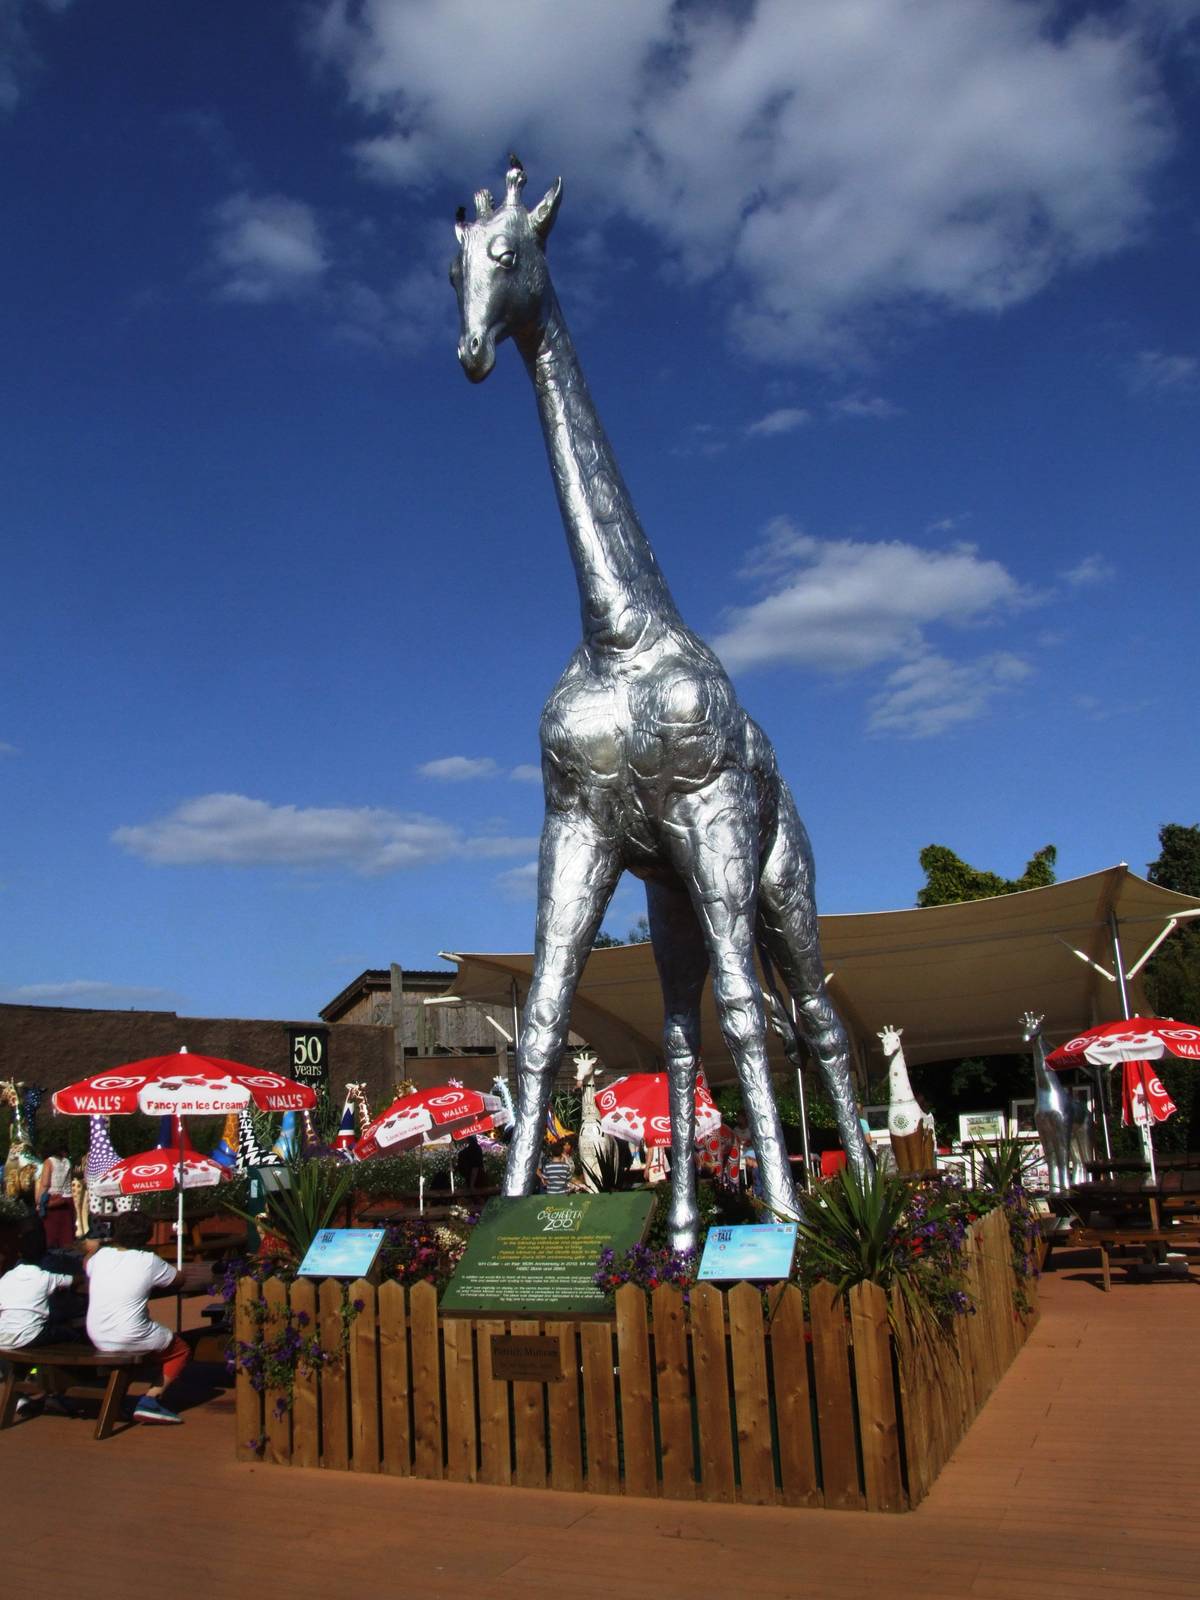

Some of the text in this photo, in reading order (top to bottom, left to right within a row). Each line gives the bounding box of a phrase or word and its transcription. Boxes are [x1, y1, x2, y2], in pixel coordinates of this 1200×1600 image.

[294, 1035, 322, 1064] 50
[295, 1065, 322, 1078] years
[74, 1096, 121, 1110] WALL'S
[147, 1101, 178, 1113] Fancy
[196, 1101, 210, 1110] Ice
[212, 1100, 248, 1110] Cream?
[266, 1095, 304, 1108] WALL'S
[442, 1105, 469, 1119] WALL'S
[461, 1124, 482, 1136] WALL'S
[132, 1181, 160, 1189] WALL'S
[542, 1218, 573, 1231] ZOO
